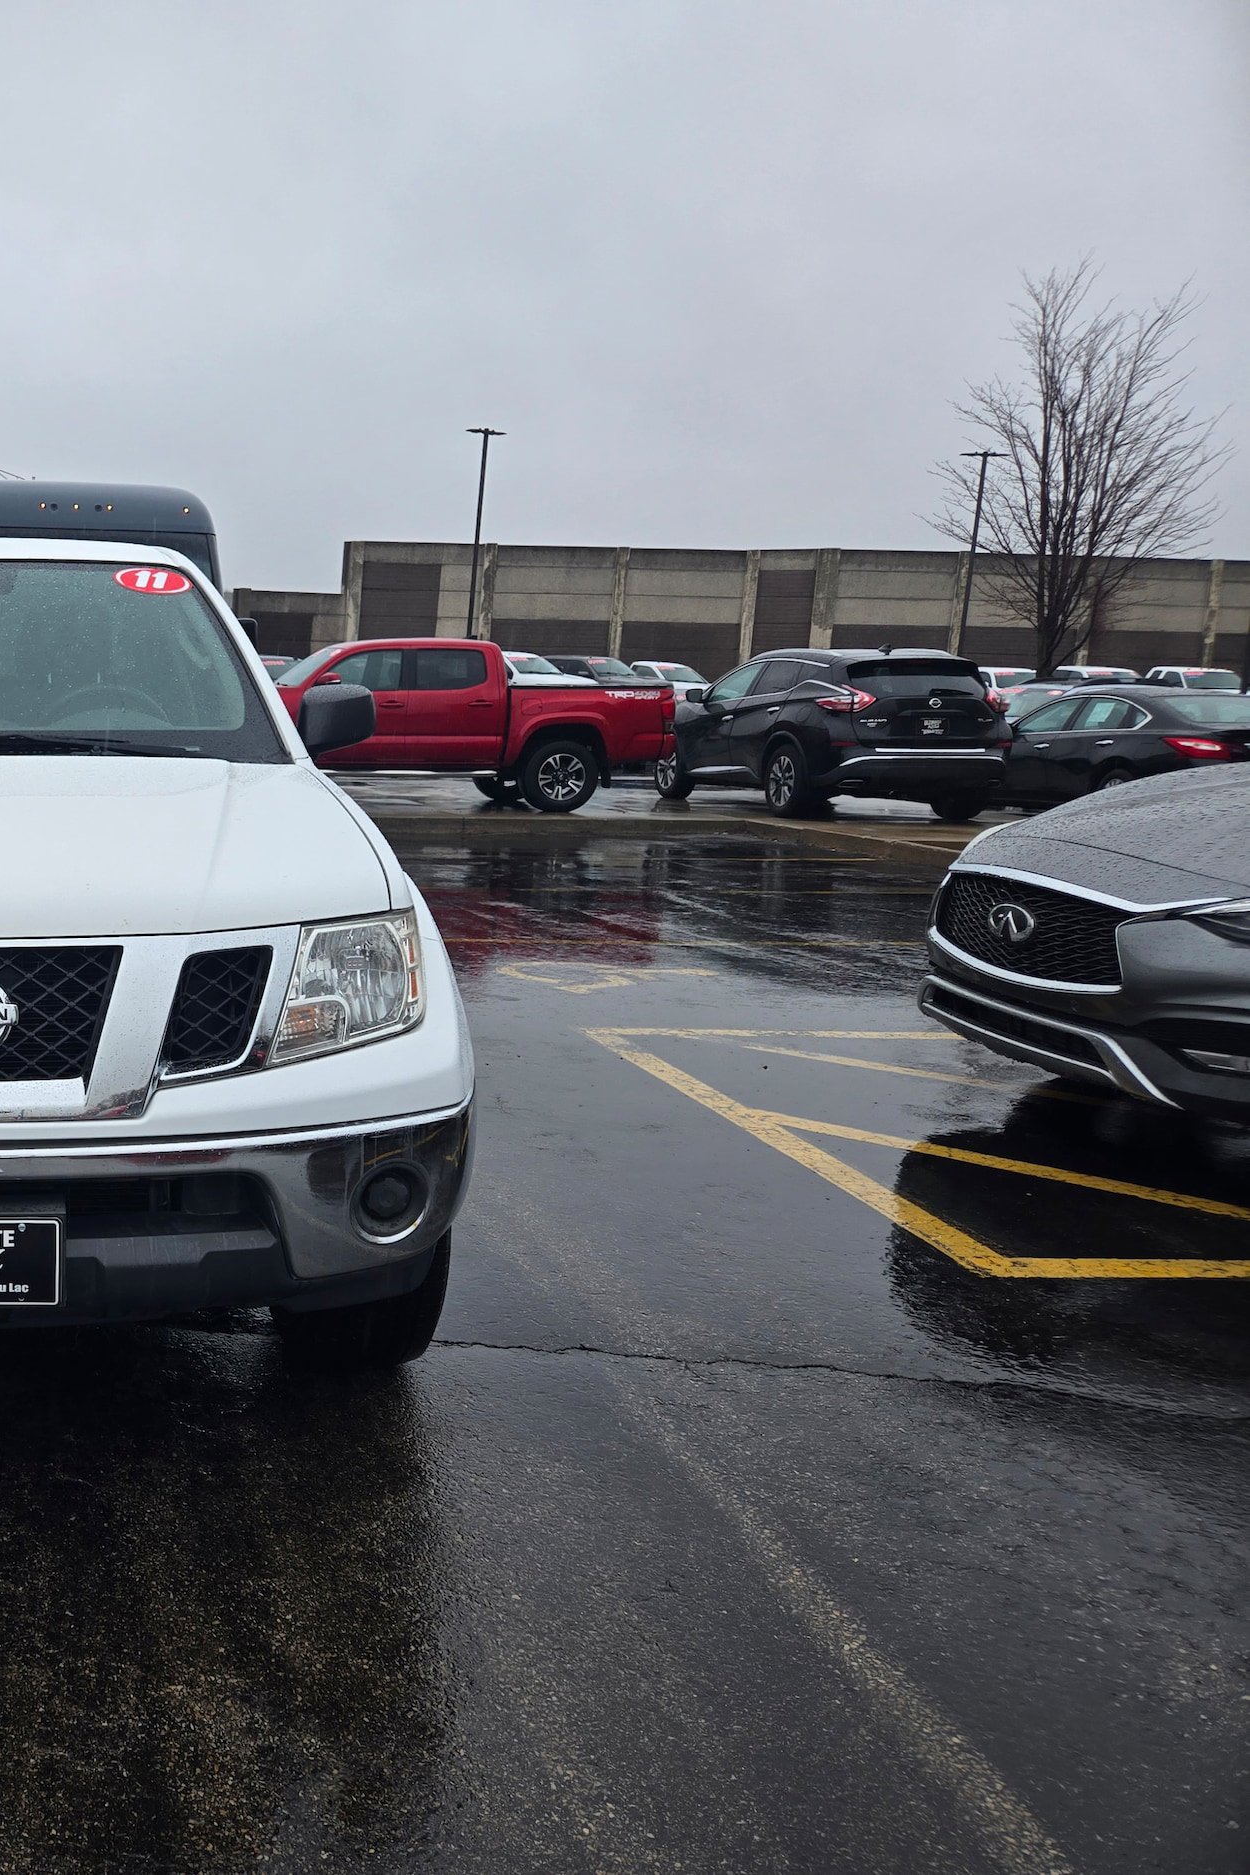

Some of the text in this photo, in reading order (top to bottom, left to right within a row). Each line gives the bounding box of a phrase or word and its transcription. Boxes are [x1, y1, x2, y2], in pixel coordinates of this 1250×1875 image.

[134, 570, 168, 589] 11
[605, 691, 634, 699] TRD
[9, 1283, 29, 1293] Lac
